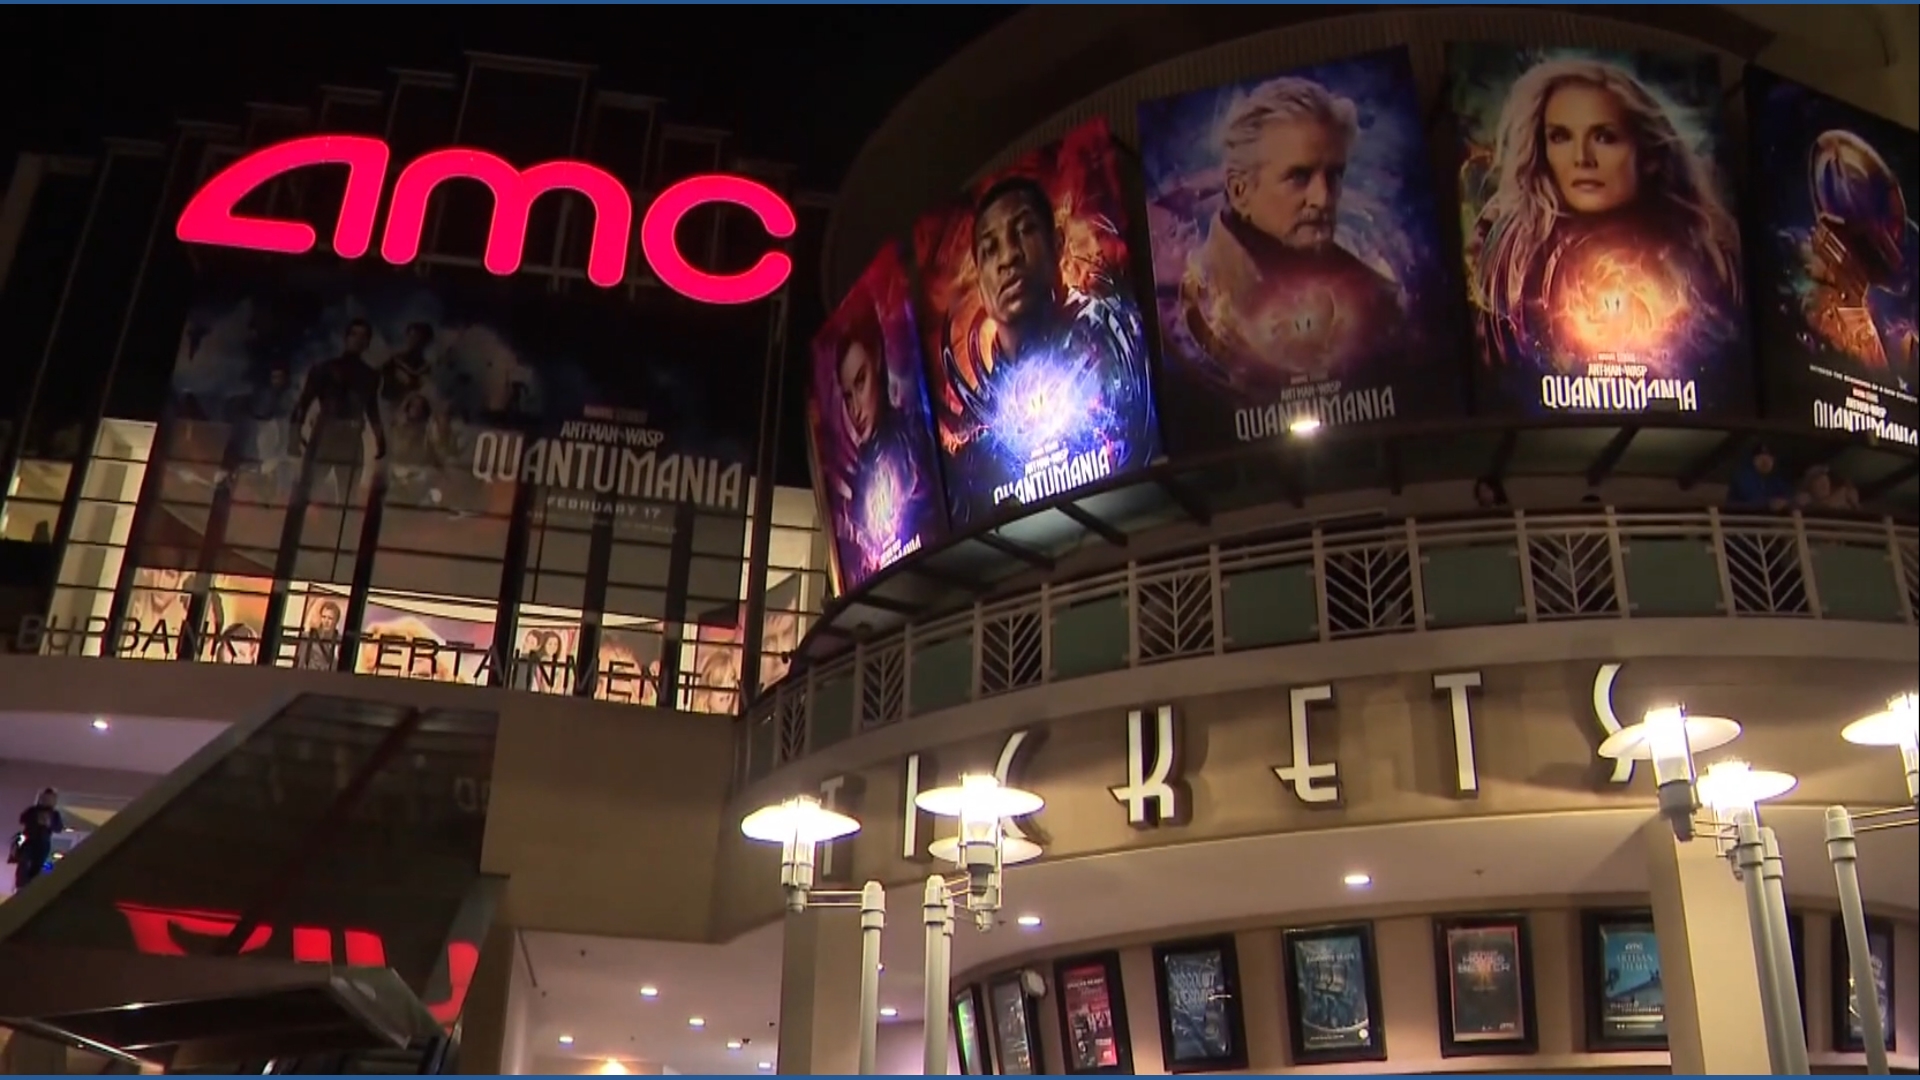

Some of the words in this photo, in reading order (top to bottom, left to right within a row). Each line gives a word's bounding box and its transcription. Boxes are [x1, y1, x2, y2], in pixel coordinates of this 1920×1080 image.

[1541, 374, 1697, 411] QUANTUMANIA
[1235, 385, 1396, 442] QUANTUMANIA
[625, 425, 665, 450] WASP
[471, 431, 744, 510] QUANTUMANIA
[546, 495, 637, 516] FEBRUARY
[643, 506, 662, 520] 17
